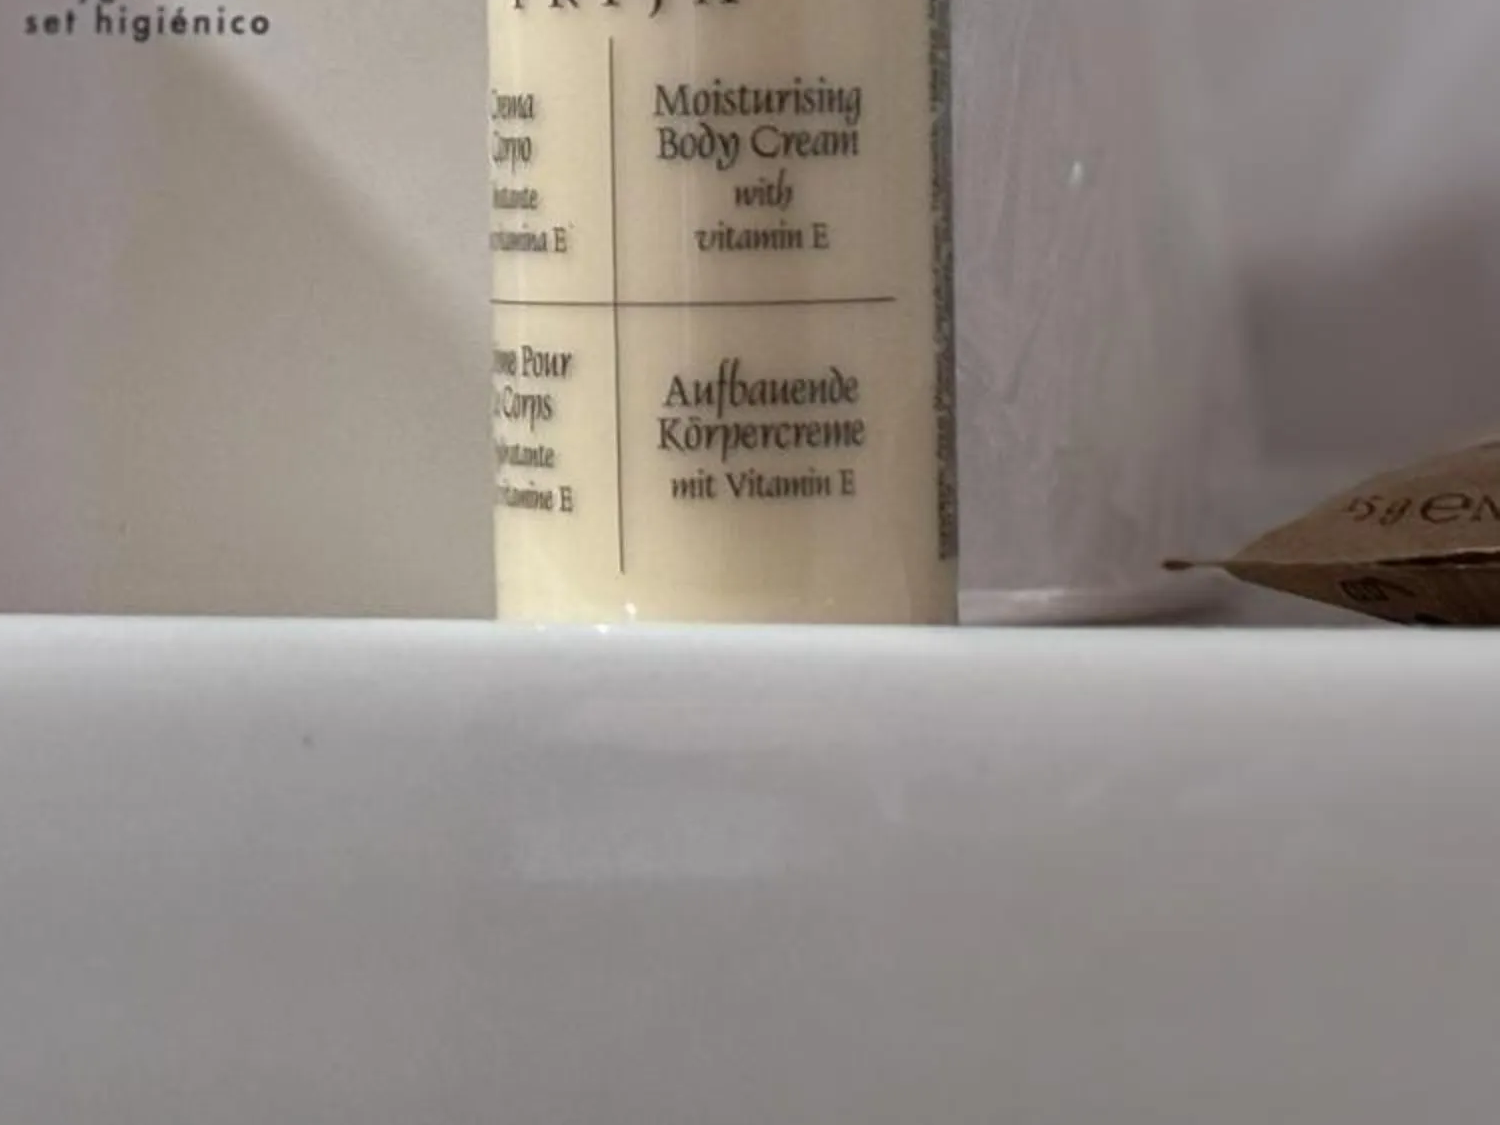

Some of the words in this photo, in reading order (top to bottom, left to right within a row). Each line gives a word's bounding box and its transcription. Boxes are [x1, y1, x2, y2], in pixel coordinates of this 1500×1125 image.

[25, 9, 76, 35] set
[95, 5, 270, 43] higiénico
[654, 78, 862, 124] Moisturising
[656, 122, 740, 171] Body
[750, 125, 859, 156] Cream
[734, 168, 793, 207] with
[552, 226, 568, 253] E
[694, 219, 804, 252] vitamin
[812, 223, 830, 250] E
[521, 344, 573, 379] Pour
[663, 357, 859, 418] Aufbauende
[503, 384, 554, 432] Corps
[657, 416, 866, 462] Körpercreme
[559, 485, 574, 513] E
[671, 469, 717, 501] mit
[726, 467, 832, 500] Vitamin
[839, 469, 857, 497] E
